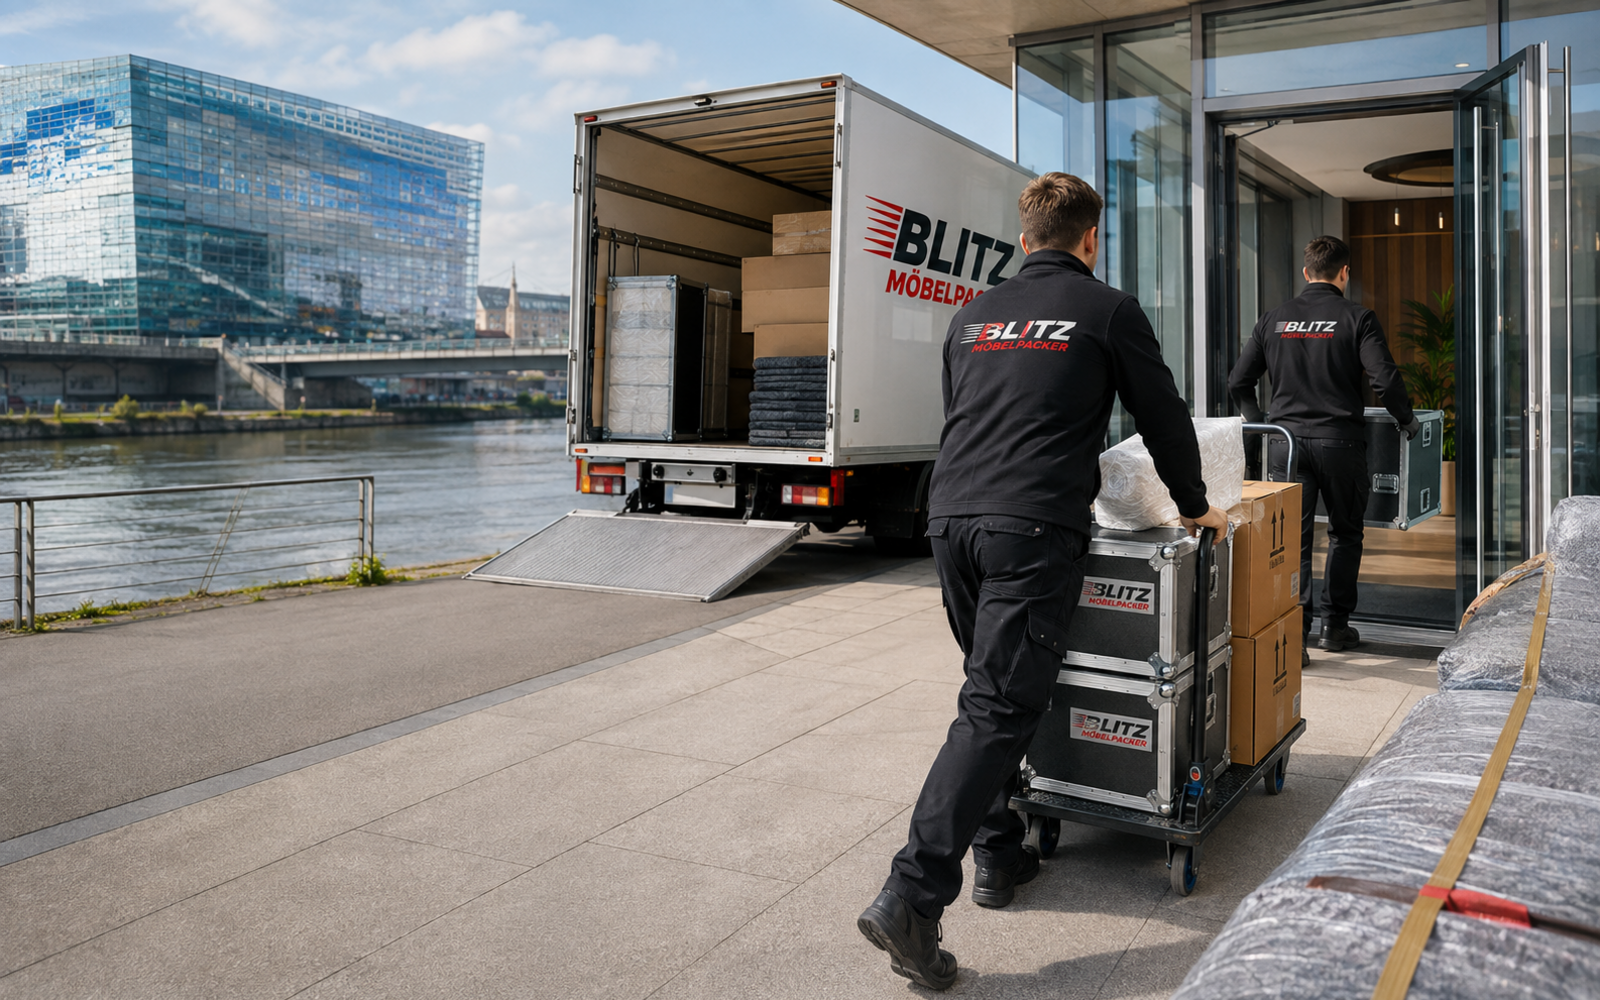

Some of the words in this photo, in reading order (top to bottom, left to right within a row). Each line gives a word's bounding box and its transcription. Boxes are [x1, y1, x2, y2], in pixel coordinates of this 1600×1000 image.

[893, 208, 1015, 287] BLITZ
[885, 268, 984, 308] MÖBELPA
[976, 320, 1077, 342] BLITZ
[1284, 321, 1338, 332] BLITZ
[1092, 582, 1152, 603] BLITZ
[1083, 715, 1150, 739] BLITZ
